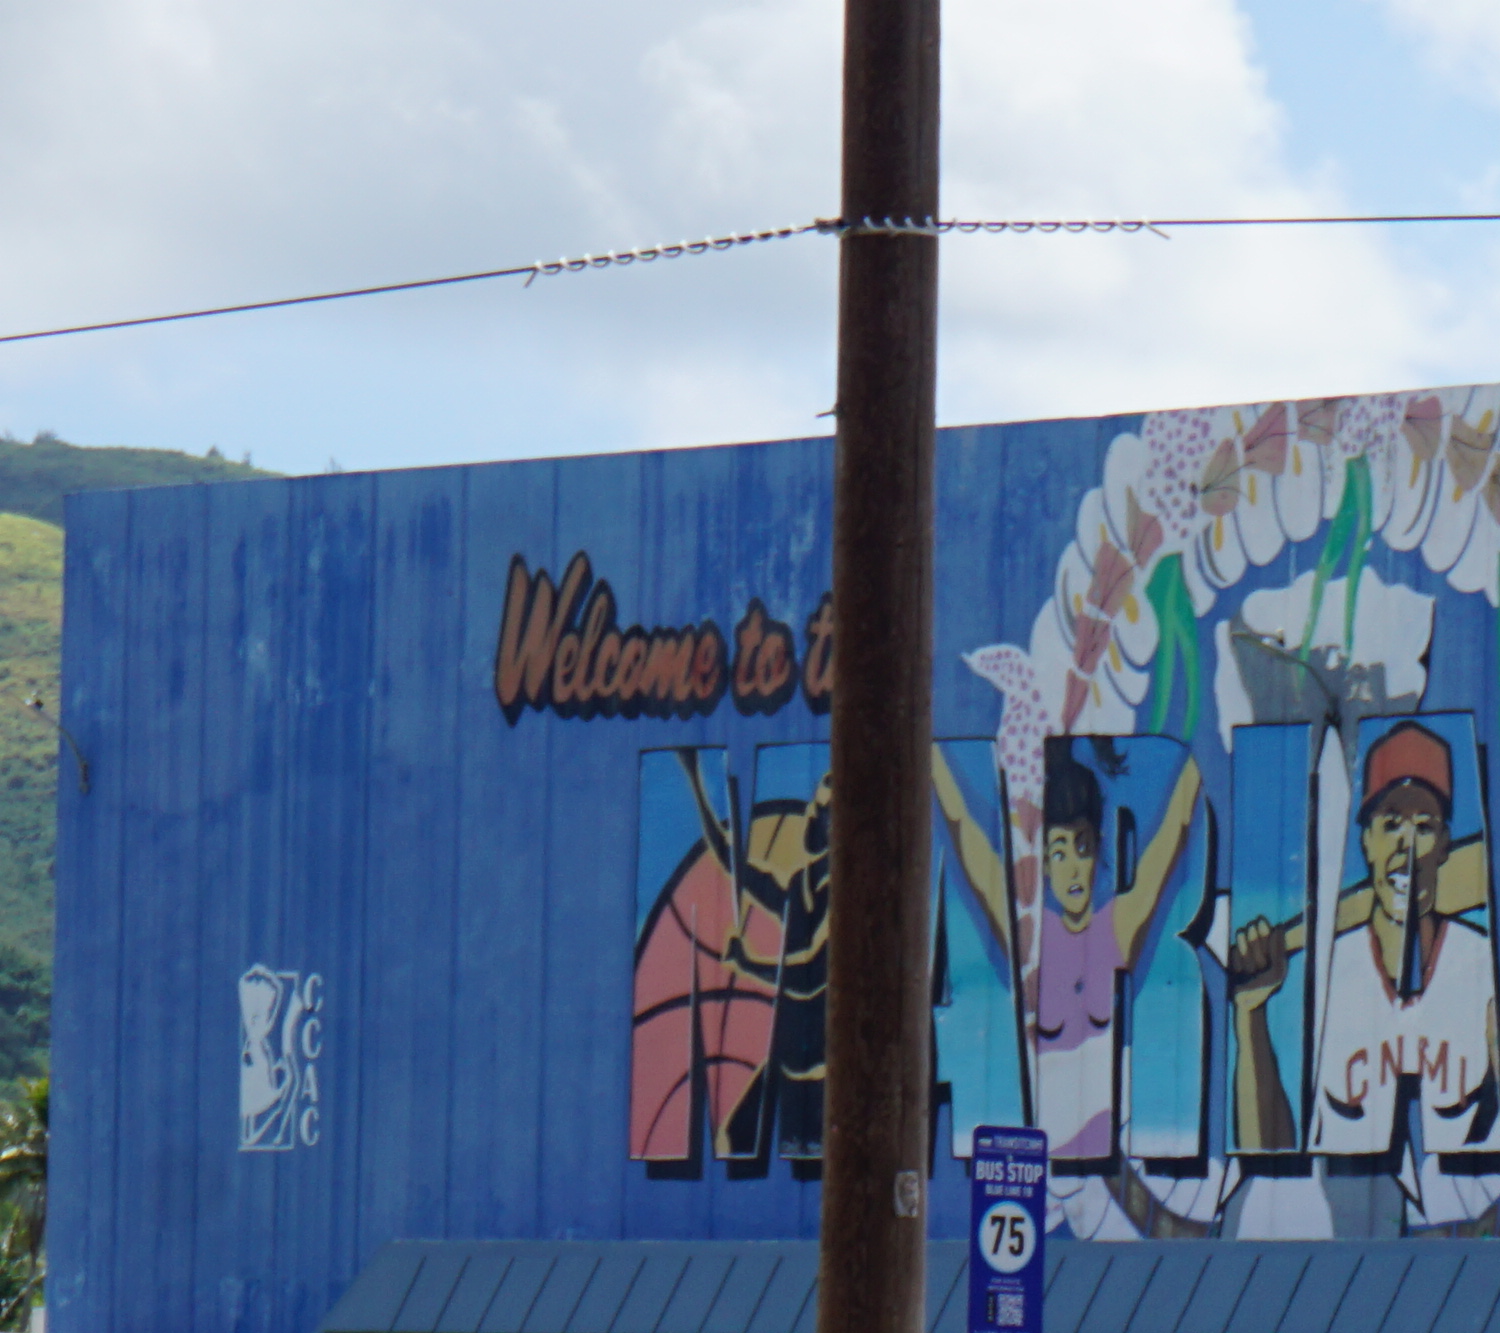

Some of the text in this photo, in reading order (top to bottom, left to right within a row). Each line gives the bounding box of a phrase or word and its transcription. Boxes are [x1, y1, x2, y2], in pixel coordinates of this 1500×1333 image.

[495, 550, 729, 726] Welcome
[732, 597, 797, 717] to
[1345, 1034, 1467, 1108] CNMI
[975, 1160, 1044, 1184] BUS STOP
[990, 1214, 1025, 1256] 75
